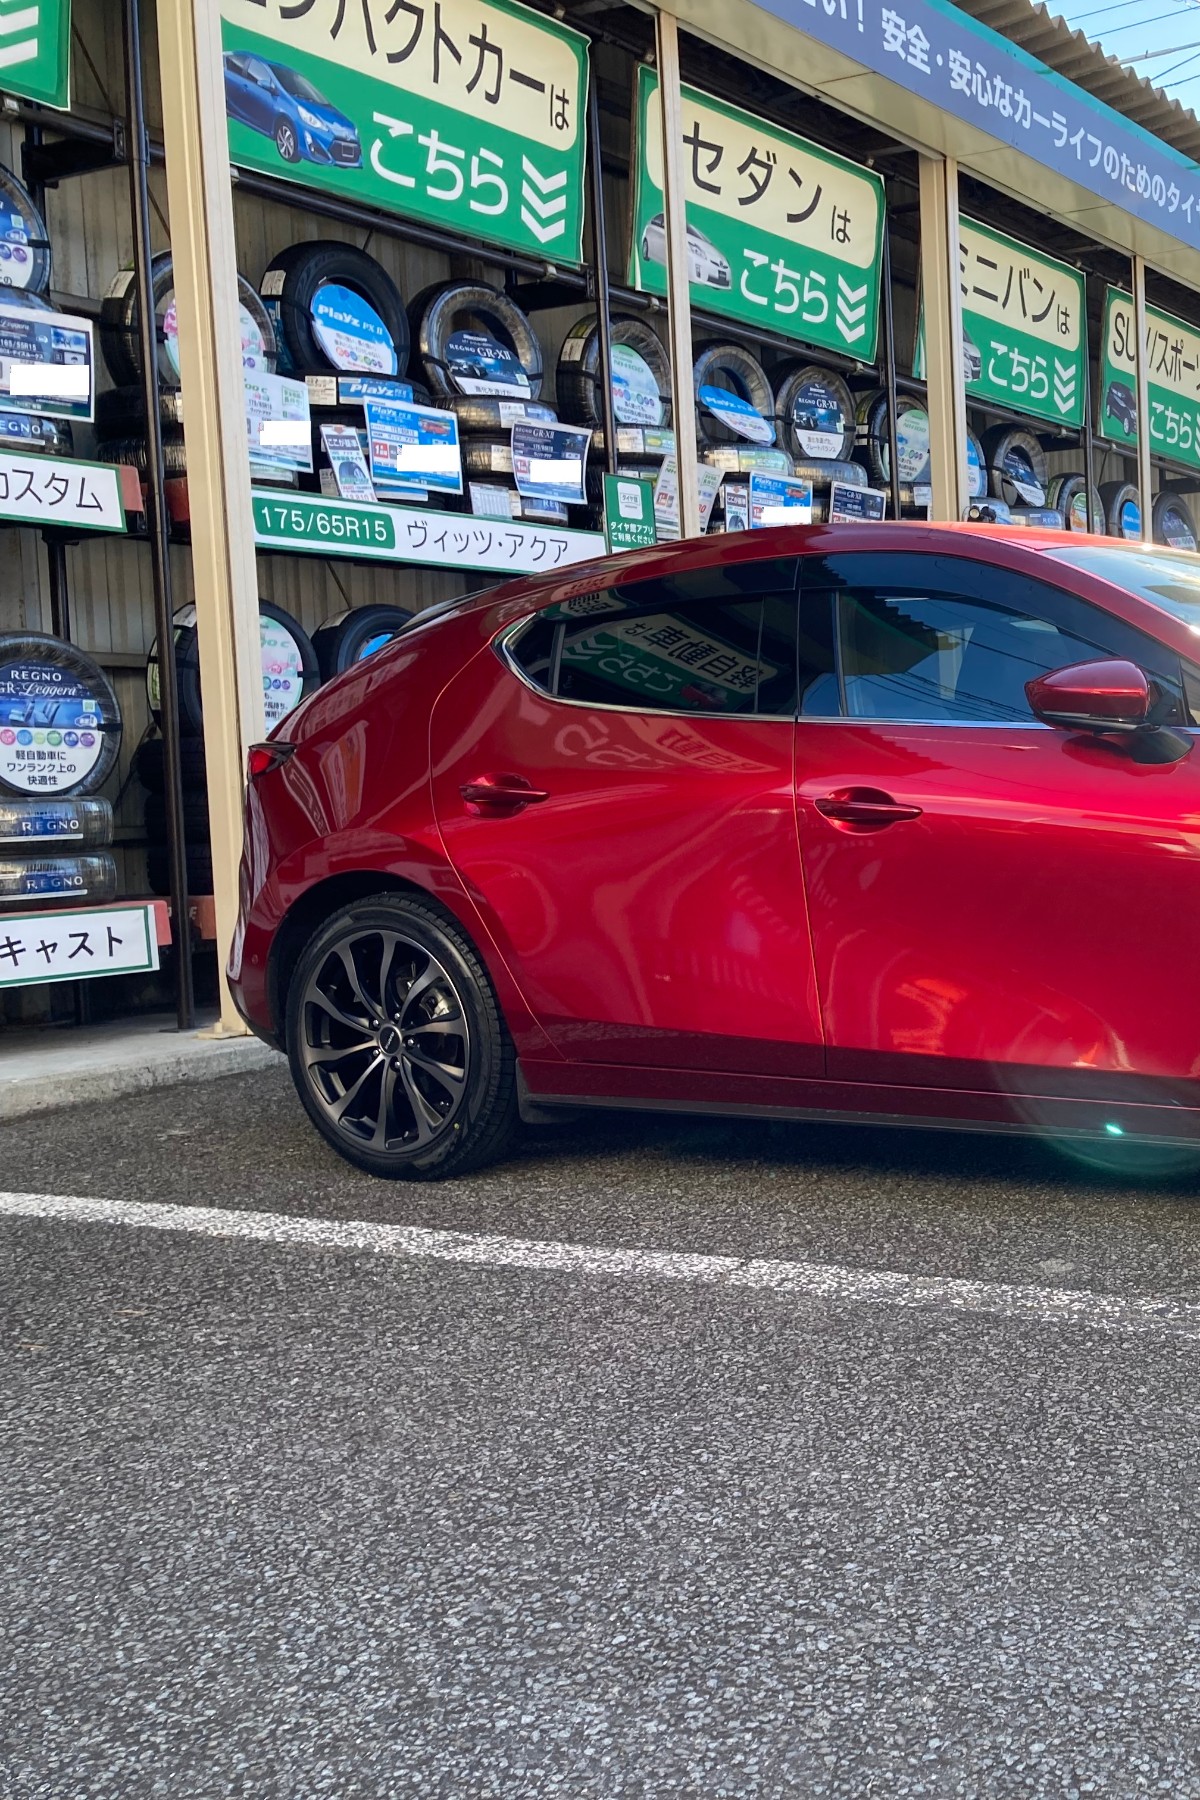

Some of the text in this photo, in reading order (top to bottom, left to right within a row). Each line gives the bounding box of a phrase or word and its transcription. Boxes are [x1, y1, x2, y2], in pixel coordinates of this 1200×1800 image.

[246, 0, 571, 131] クトカーは
[369, 110, 510, 216] こちら
[683, 120, 852, 245] セダンは
[740, 247, 830, 324] こちら
[449, 343, 476, 353] REGNO
[987, 340, 1050, 399] こちら
[1149, 401, 1193, 450] こちら
[261, 506, 568, 564] 175/65R15 ヴィッツ・アクア
[10, 669, 62, 682] REGNO
[6, 762, 77, 773] ワンランク上の
[15, 749, 67, 761] 軽自動車に
[27, 775, 59, 786] 快適性
[22, 819, 79, 832] REGNO
[26, 876, 84, 890] REGNO
[0, 926, 124, 967] キャスト
